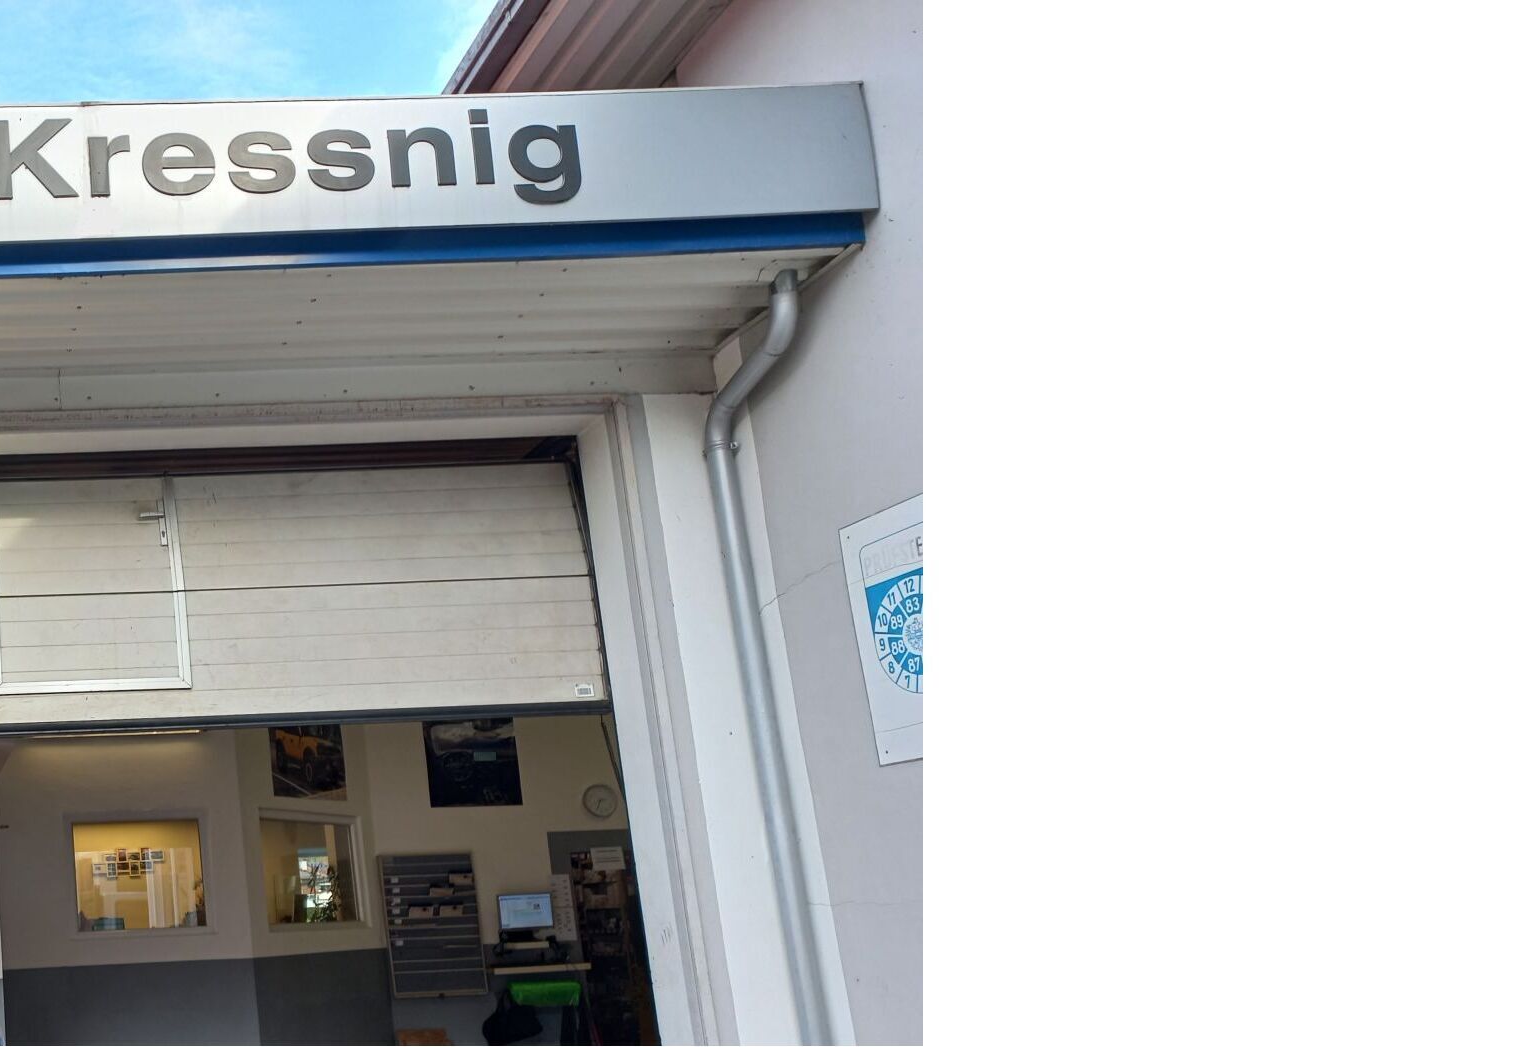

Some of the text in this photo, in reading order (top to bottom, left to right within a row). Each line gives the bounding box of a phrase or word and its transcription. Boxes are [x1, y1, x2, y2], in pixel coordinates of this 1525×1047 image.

[903, 578, 916, 594] 12
[887, 591, 897, 607] 11
[905, 596, 920, 613] 83
[877, 612, 888, 628] 10
[890, 614, 904, 630] 89
[879, 637, 886, 652] 9
[891, 639, 905, 656] 88
[888, 661, 895, 674] 8
[907, 656, 920, 673] 87
[904, 674, 911, 689] 7
